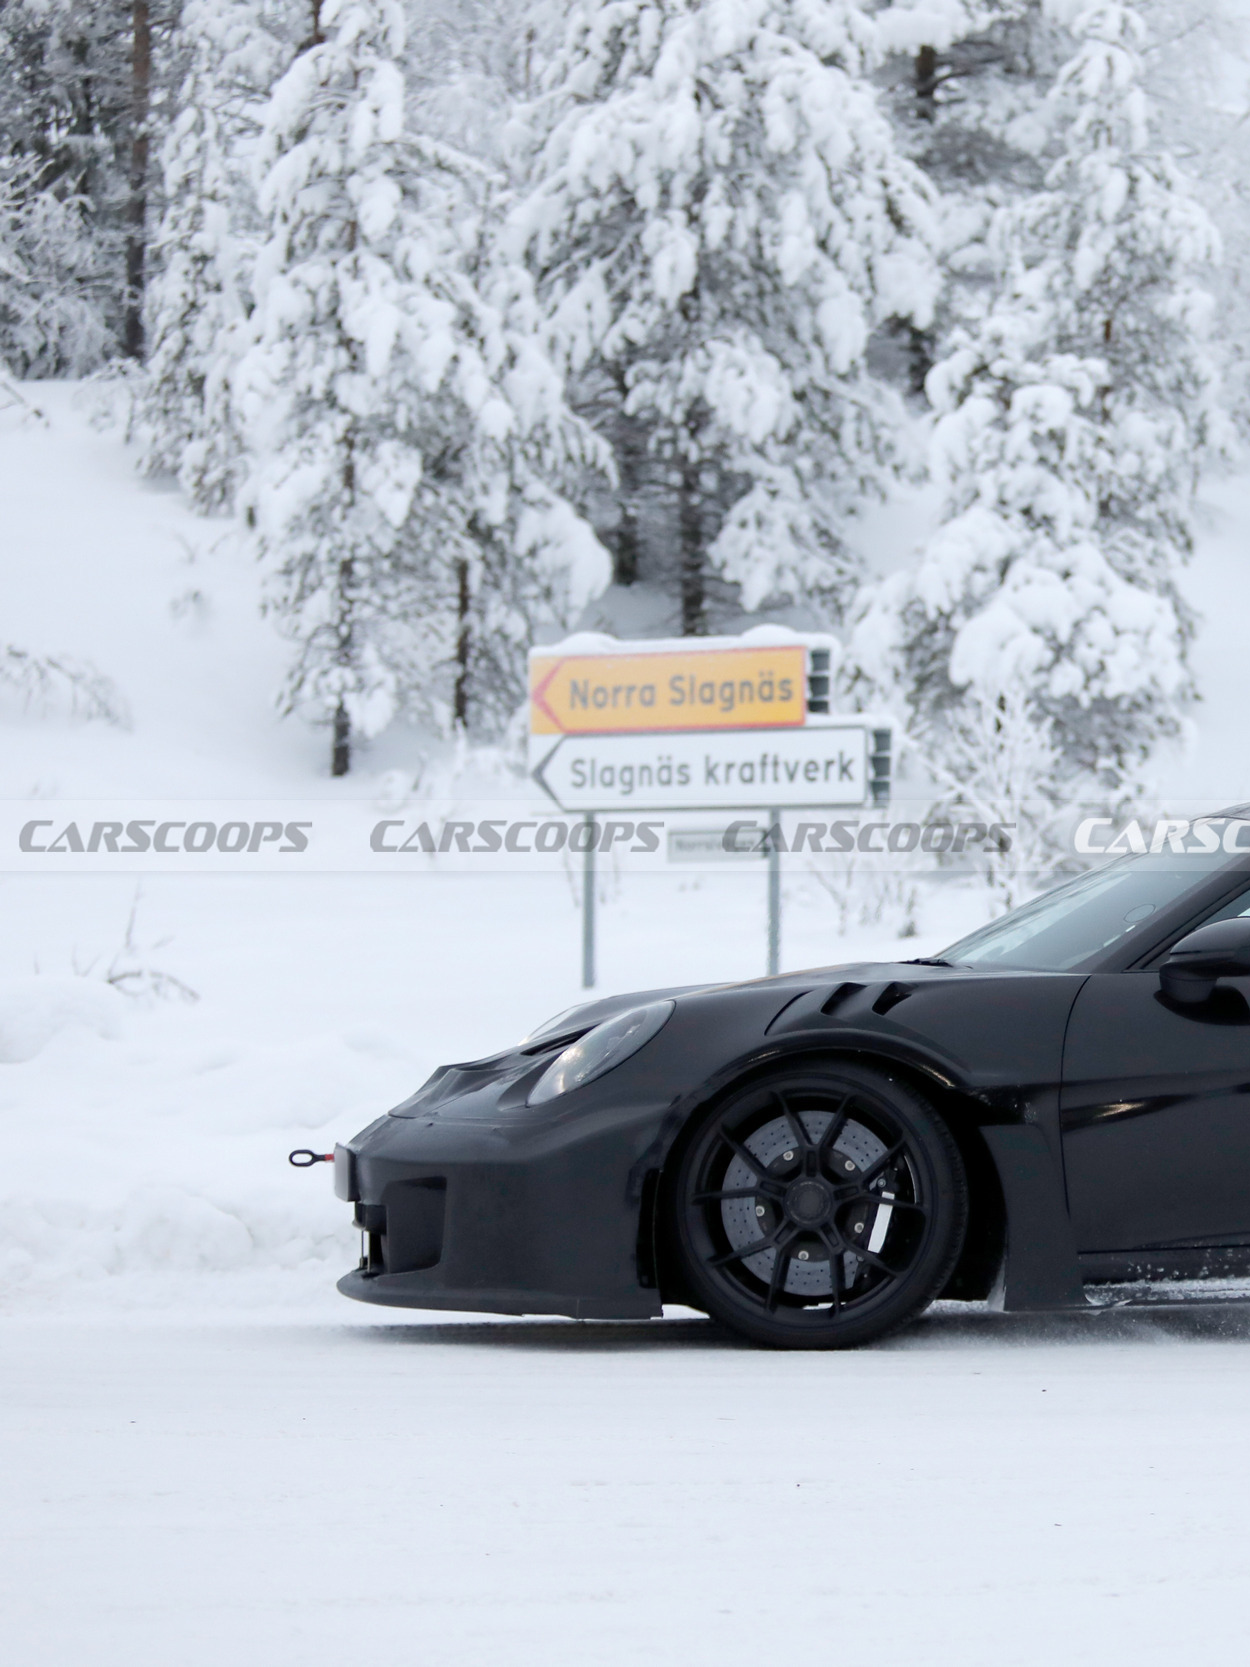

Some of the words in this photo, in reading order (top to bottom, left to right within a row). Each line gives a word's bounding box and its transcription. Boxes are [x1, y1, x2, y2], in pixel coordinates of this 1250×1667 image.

[569, 679, 656, 710] Norra
[669, 670, 793, 712] Slagnäs
[571, 755, 691, 795] Slagnäs
[705, 752, 855, 786] kraftverk
